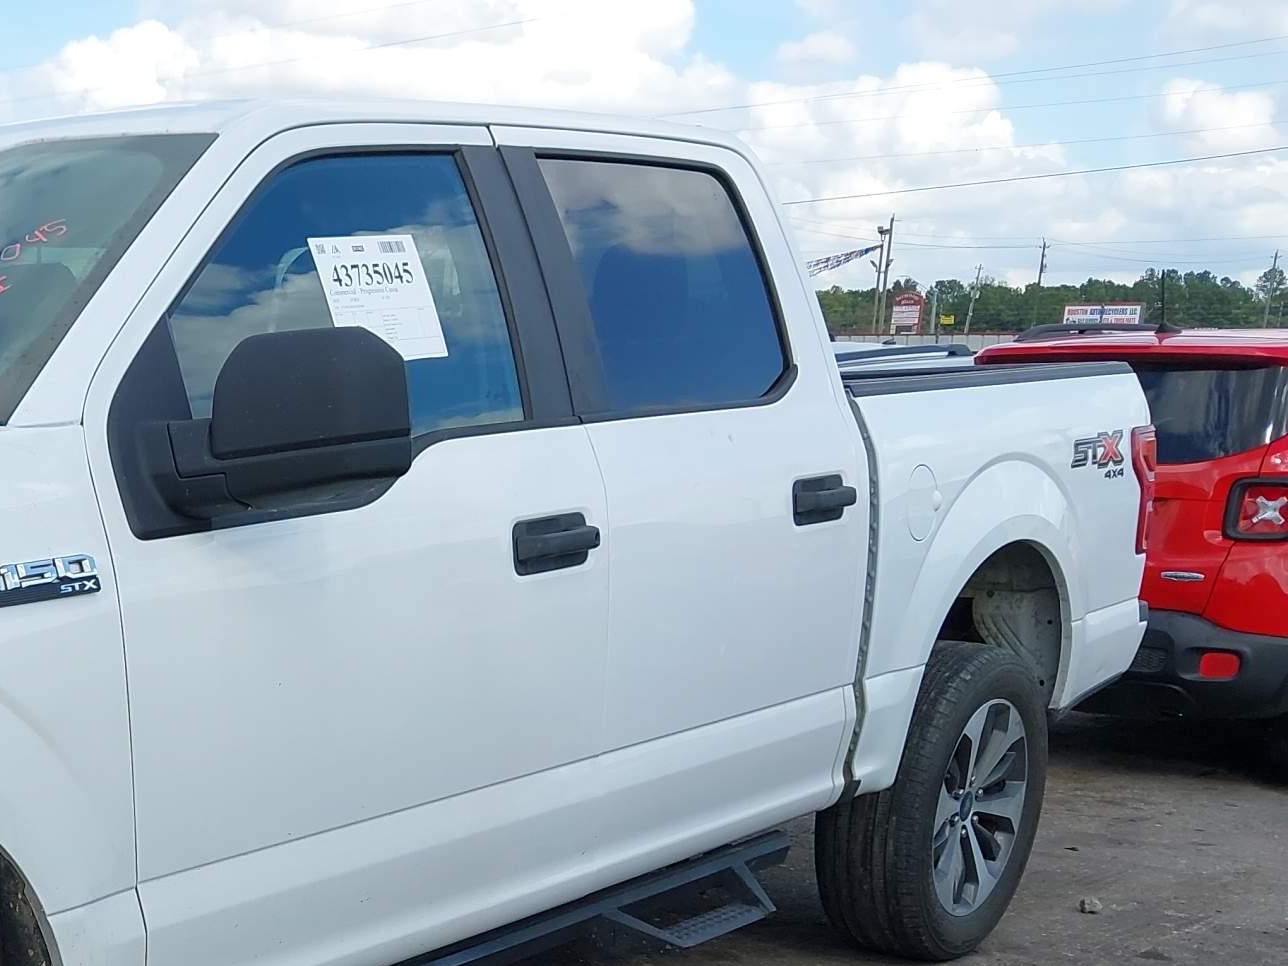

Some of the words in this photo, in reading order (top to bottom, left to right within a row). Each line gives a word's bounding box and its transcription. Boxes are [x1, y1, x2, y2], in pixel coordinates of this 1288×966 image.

[332, 262, 414, 287] 43735045
[1070, 429, 1124, 469] STX
[60, 578, 98, 594] STX
